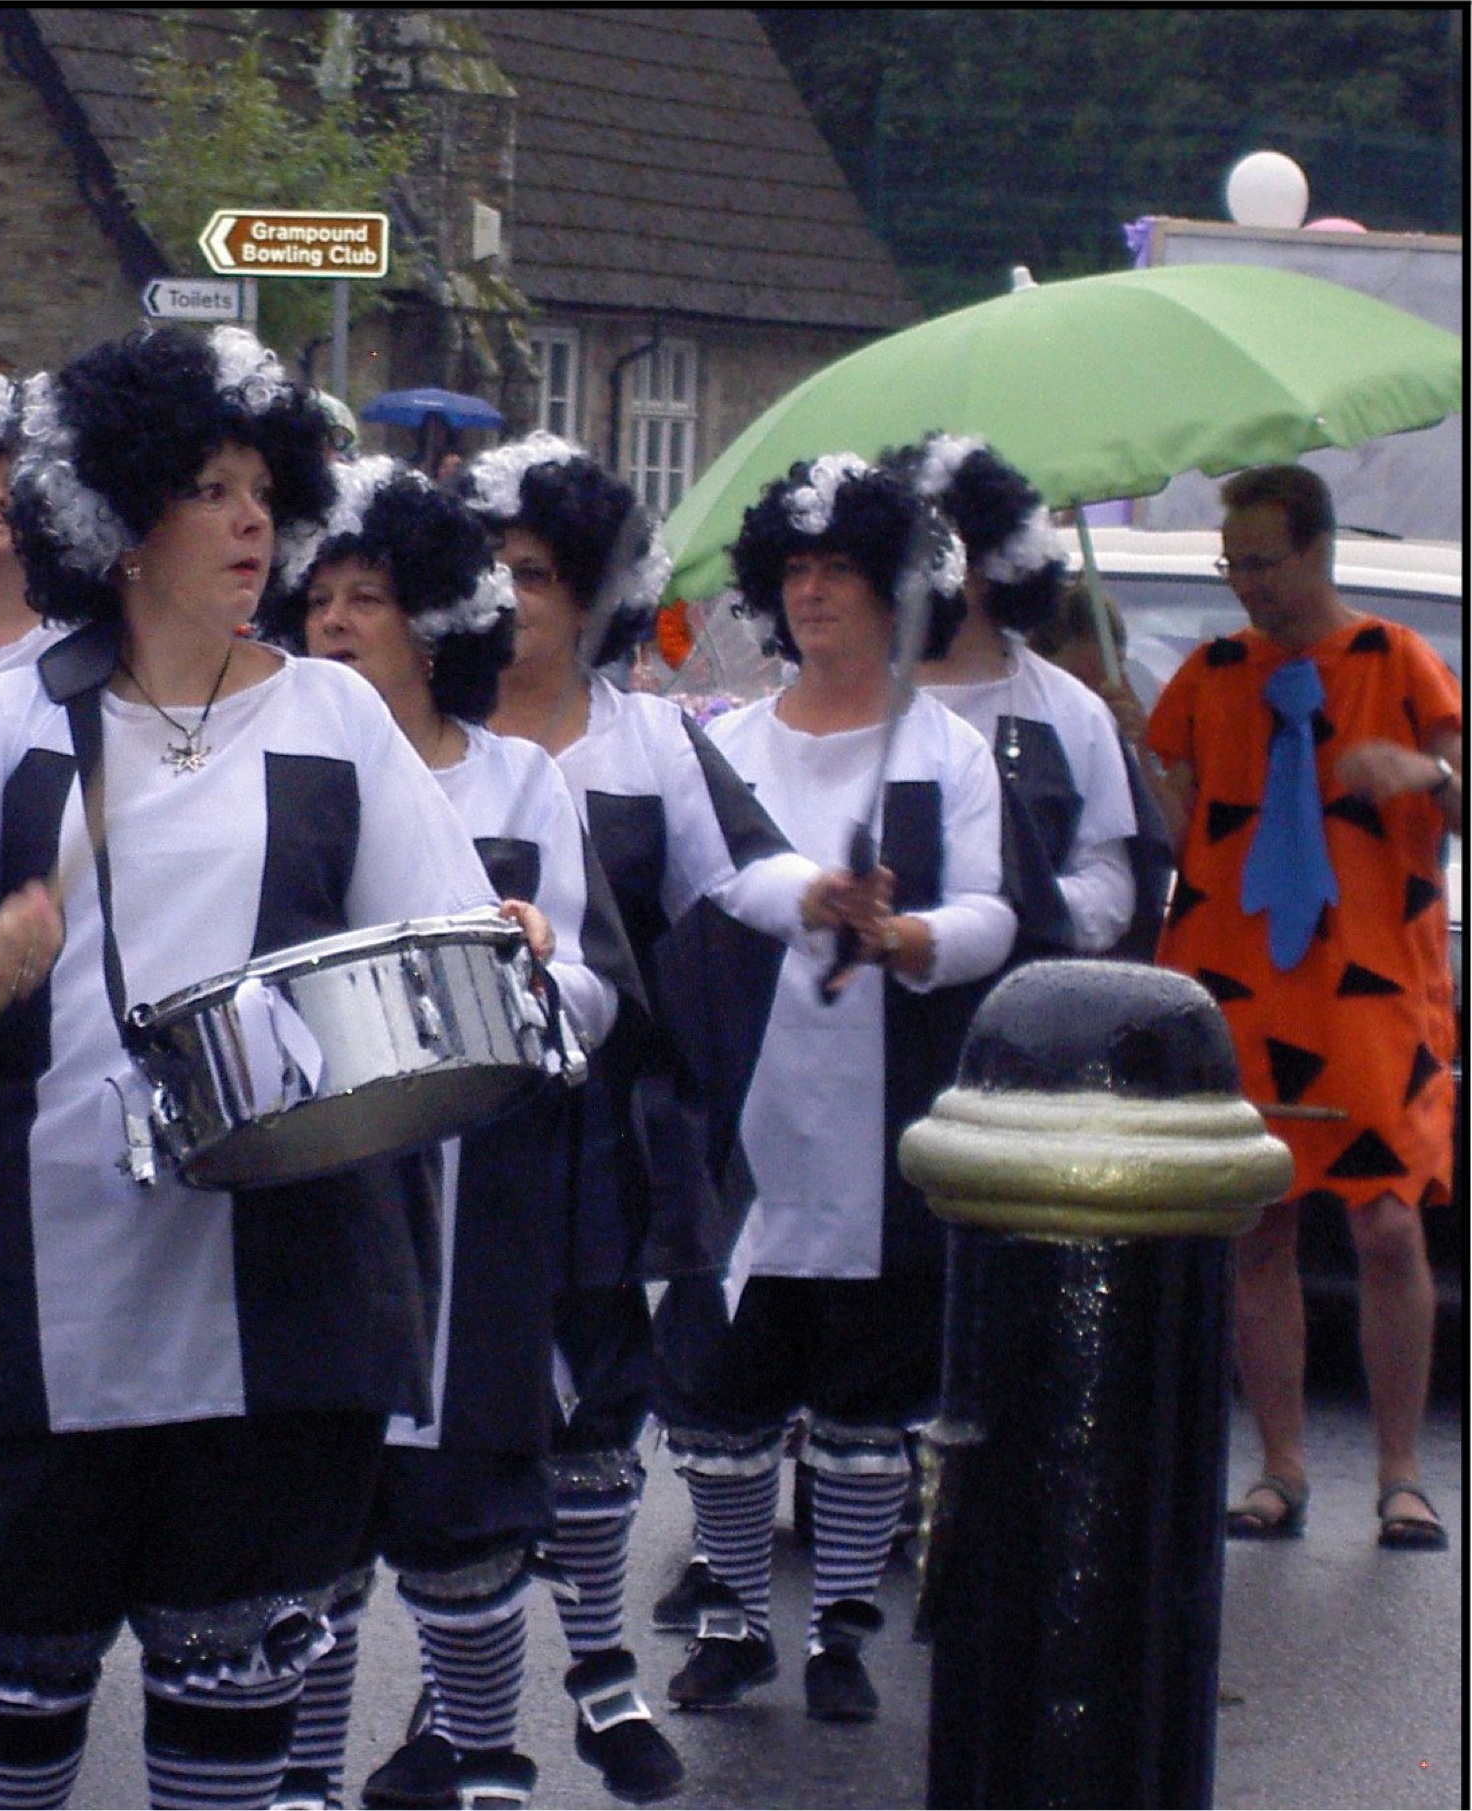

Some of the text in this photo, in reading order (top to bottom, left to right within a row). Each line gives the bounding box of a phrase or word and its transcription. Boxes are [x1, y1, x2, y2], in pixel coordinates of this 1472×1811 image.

[251, 221, 368, 244] Grampound
[242, 243, 377, 267] Bowling Club
[168, 289, 232, 310] Toilets
